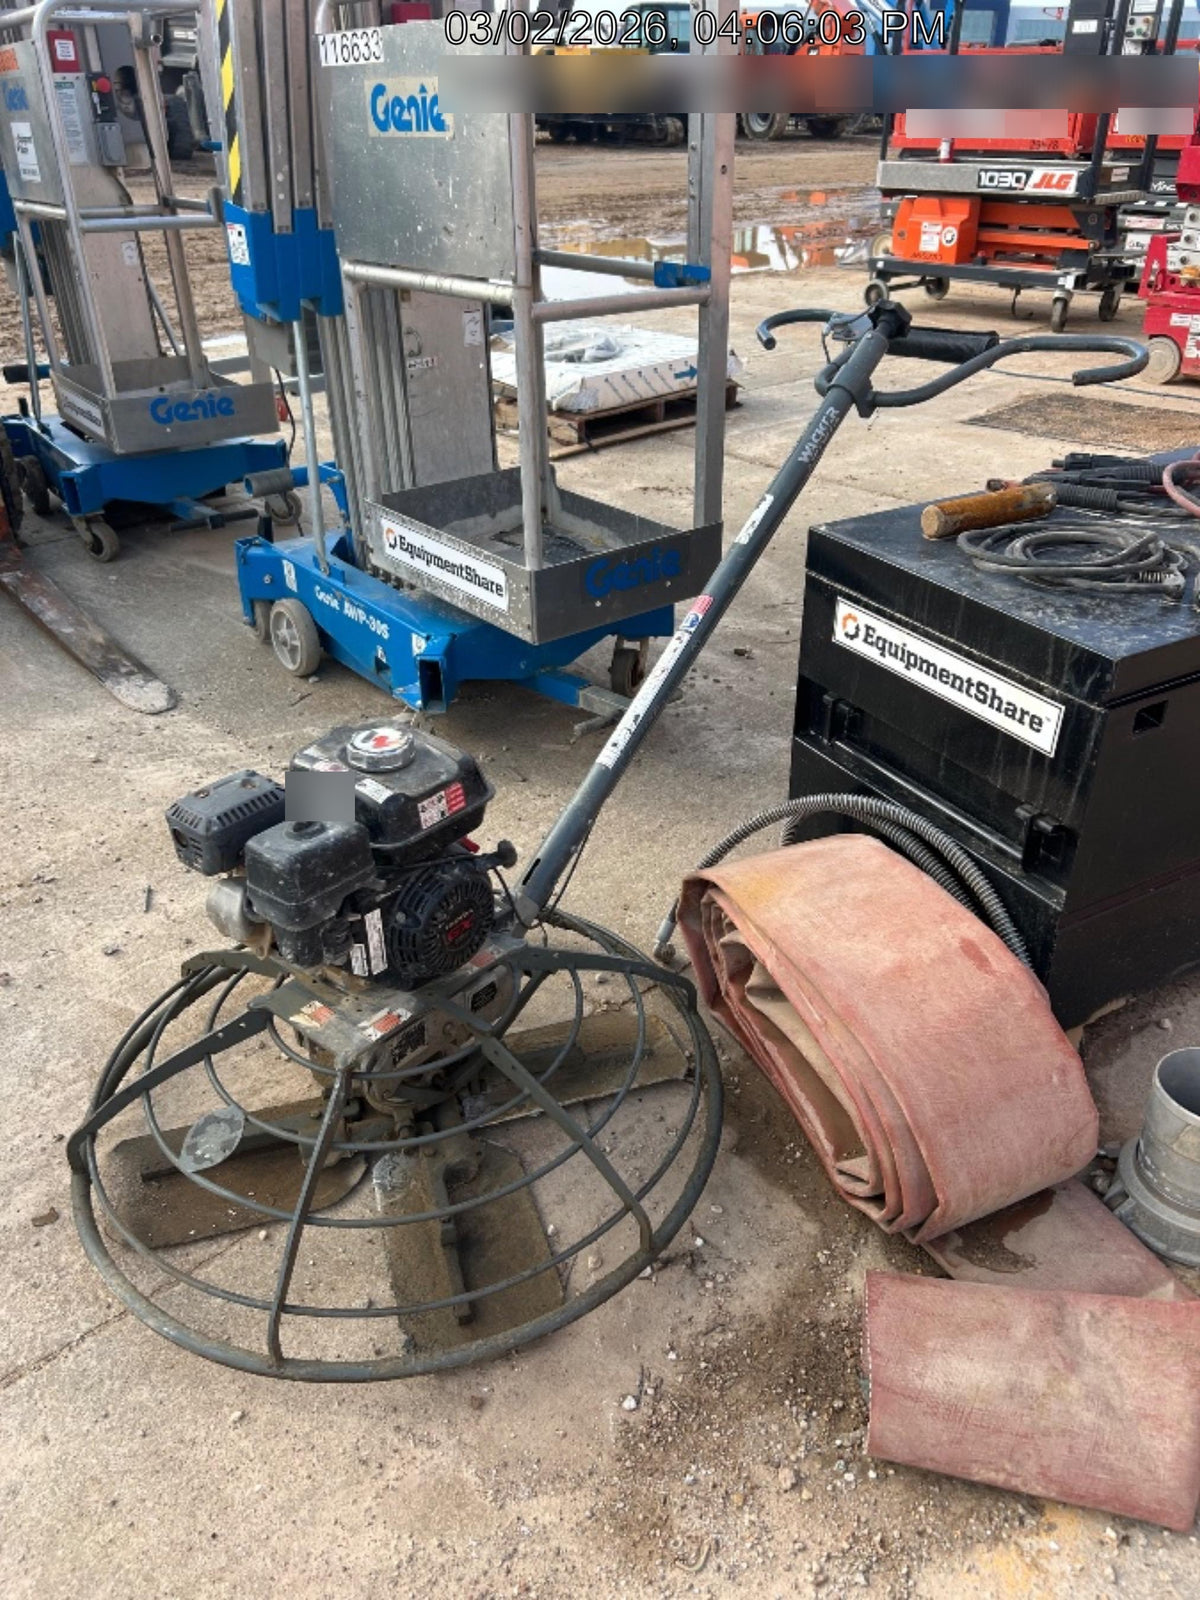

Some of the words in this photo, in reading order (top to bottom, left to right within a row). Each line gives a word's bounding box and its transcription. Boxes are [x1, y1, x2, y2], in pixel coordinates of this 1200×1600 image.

[321, 29, 382, 64] 116633
[370, 83, 447, 132] Genie
[979, 171, 1027, 189] 1030
[1032, 173, 1075, 190] JLG
[150, 394, 235, 426] Genie
[399, 535, 504, 596] EquipmentShare
[584, 548, 682, 599] Genie
[313, 585, 340, 610] Genie
[343, 600, 390, 639] AWP-30S
[862, 623, 1044, 734] EquipmentShare
